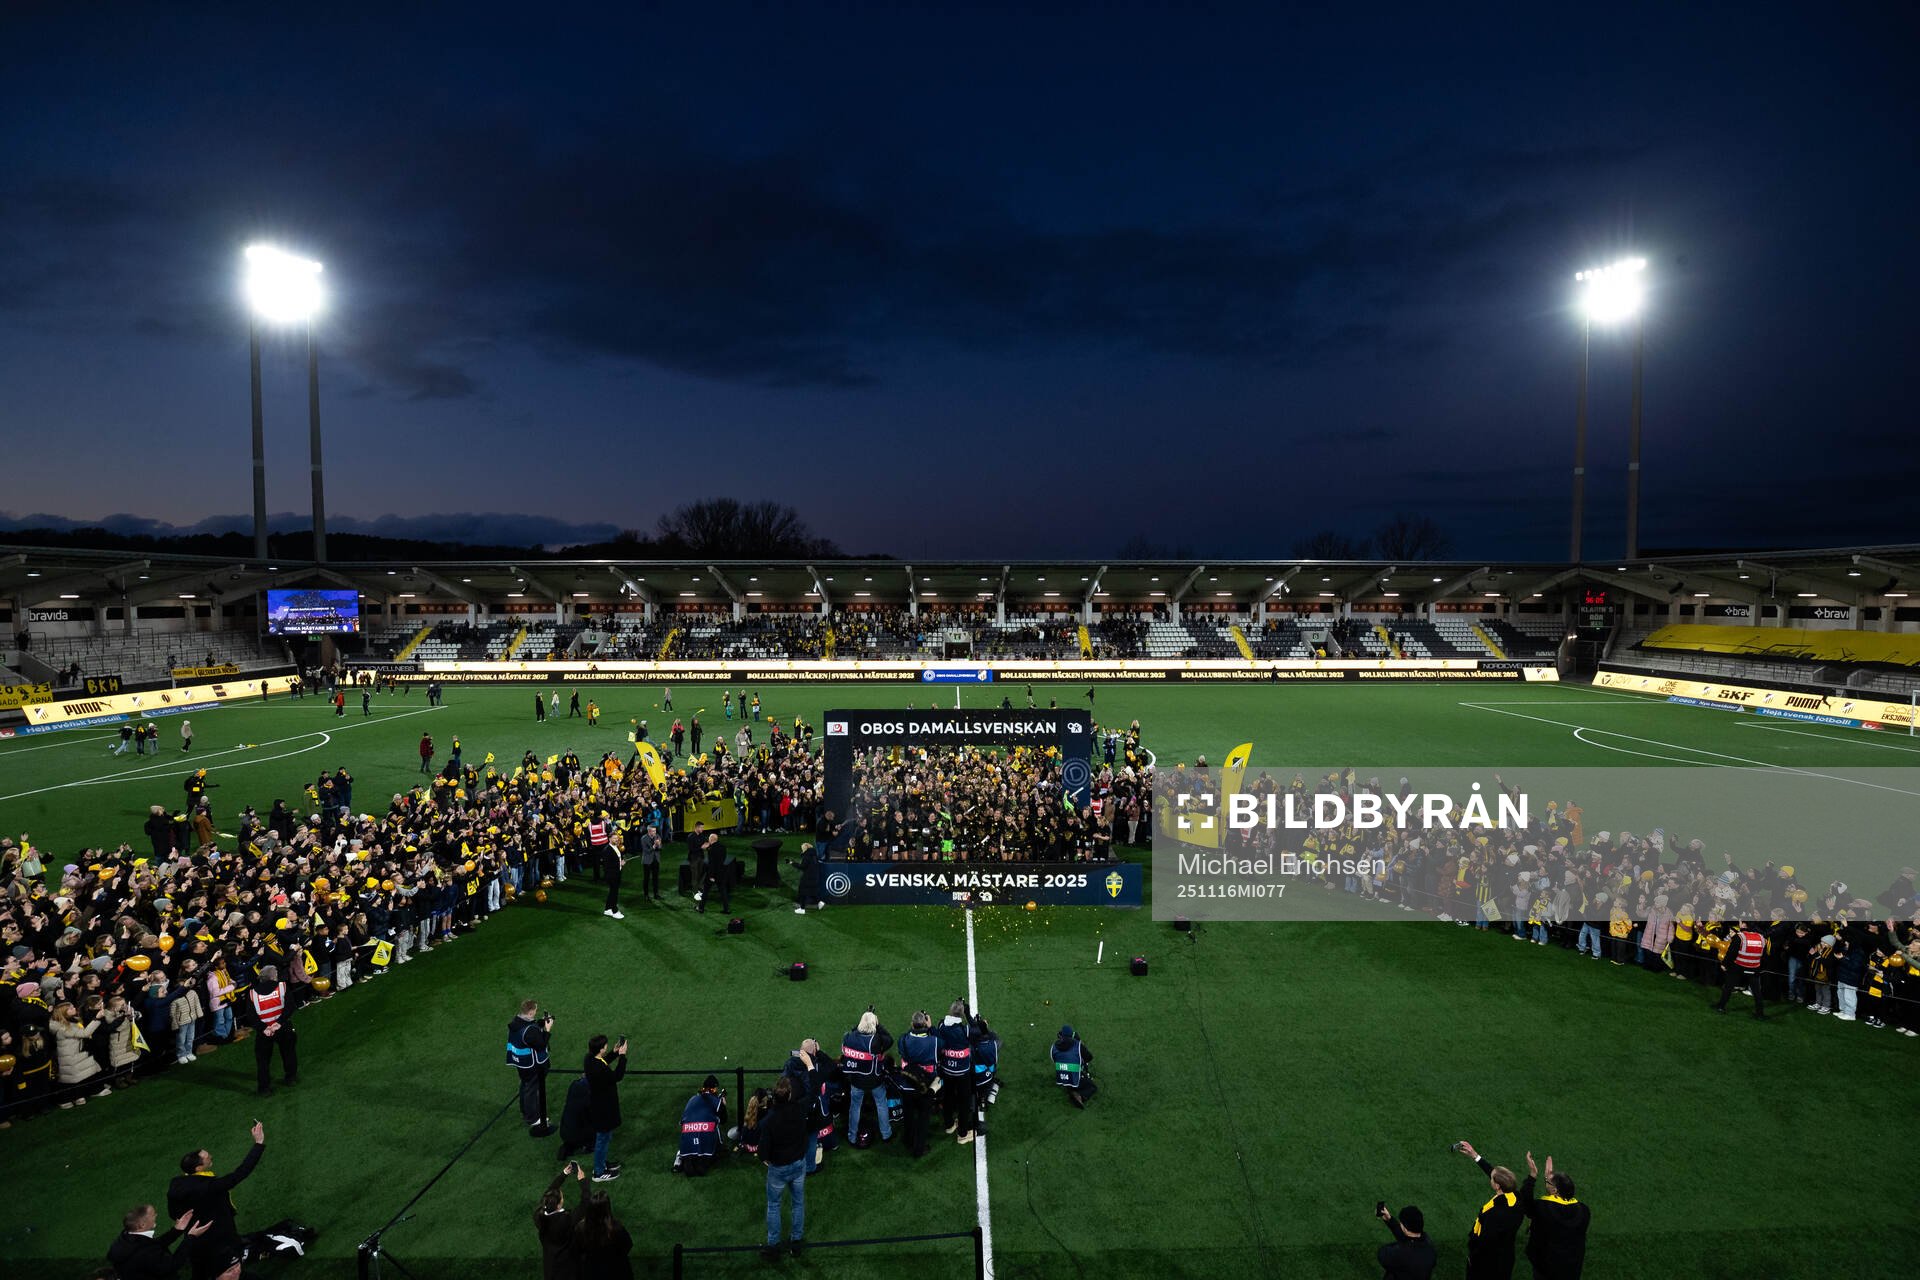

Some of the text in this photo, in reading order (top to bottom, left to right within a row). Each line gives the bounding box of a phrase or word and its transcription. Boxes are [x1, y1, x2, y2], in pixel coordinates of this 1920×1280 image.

[29, 609, 69, 621] bravida
[746, 672, 799, 680] BOLLKLUBBEN
[87, 678, 119, 695] BKH
[1717, 689, 1755, 701] SKF
[63, 701, 103, 716] PUMA
[1784, 696, 1823, 710] PUMA
[1761, 708, 1783, 717] Heja
[1783, 711, 1815, 721] svensk
[26, 724, 51, 734] Heja
[52, 720, 86, 731] svensk
[860, 721, 1057, 735] OBOS DAMALLSVENSKAN
[865, 870, 1088, 888] SVENSKA MÄSTARE 2025
[684, 1122, 709, 1131] PHOTO
